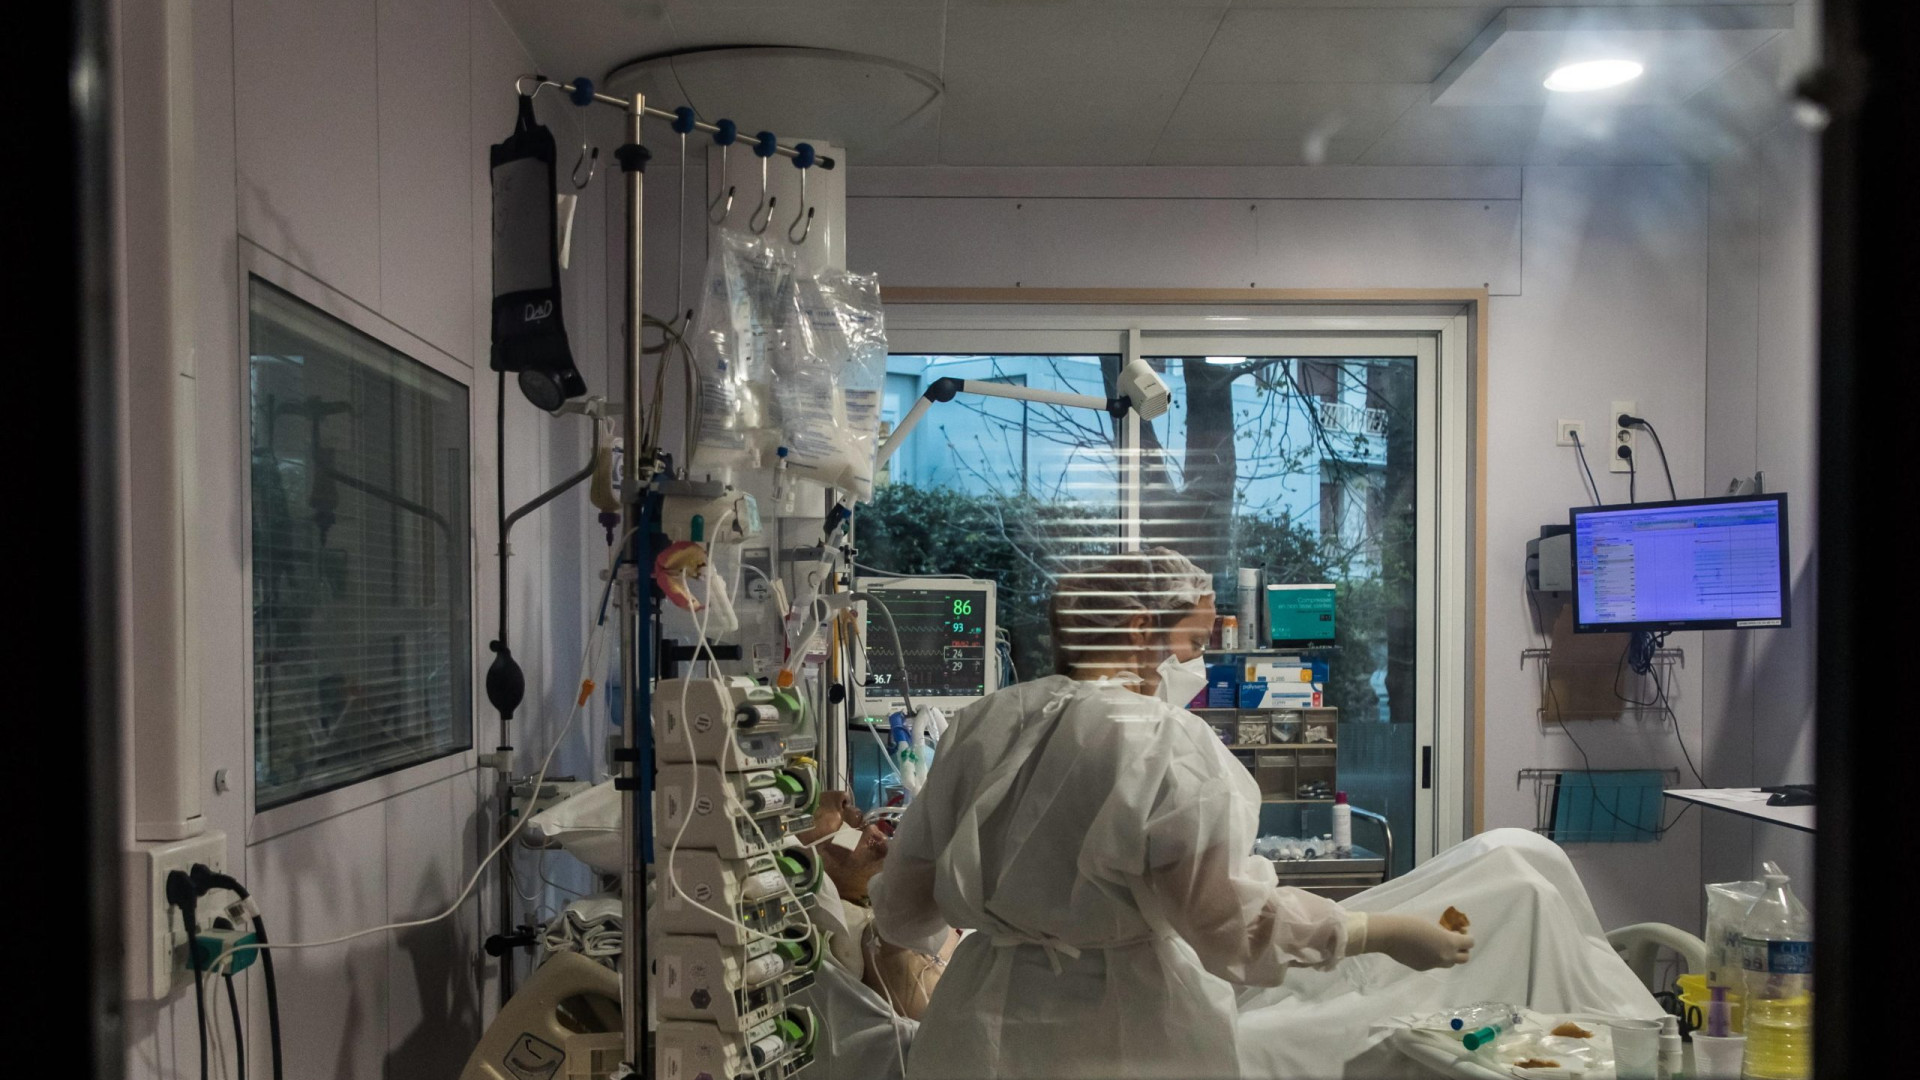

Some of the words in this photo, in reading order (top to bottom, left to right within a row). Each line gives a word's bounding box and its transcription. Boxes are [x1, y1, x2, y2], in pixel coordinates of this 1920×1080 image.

[953, 599, 972, 615] 86
[953, 622, 964, 633] 93
[952, 649, 963, 658] 24
[952, 661, 963, 671] 29
[873, 674, 892, 684] 36.7
